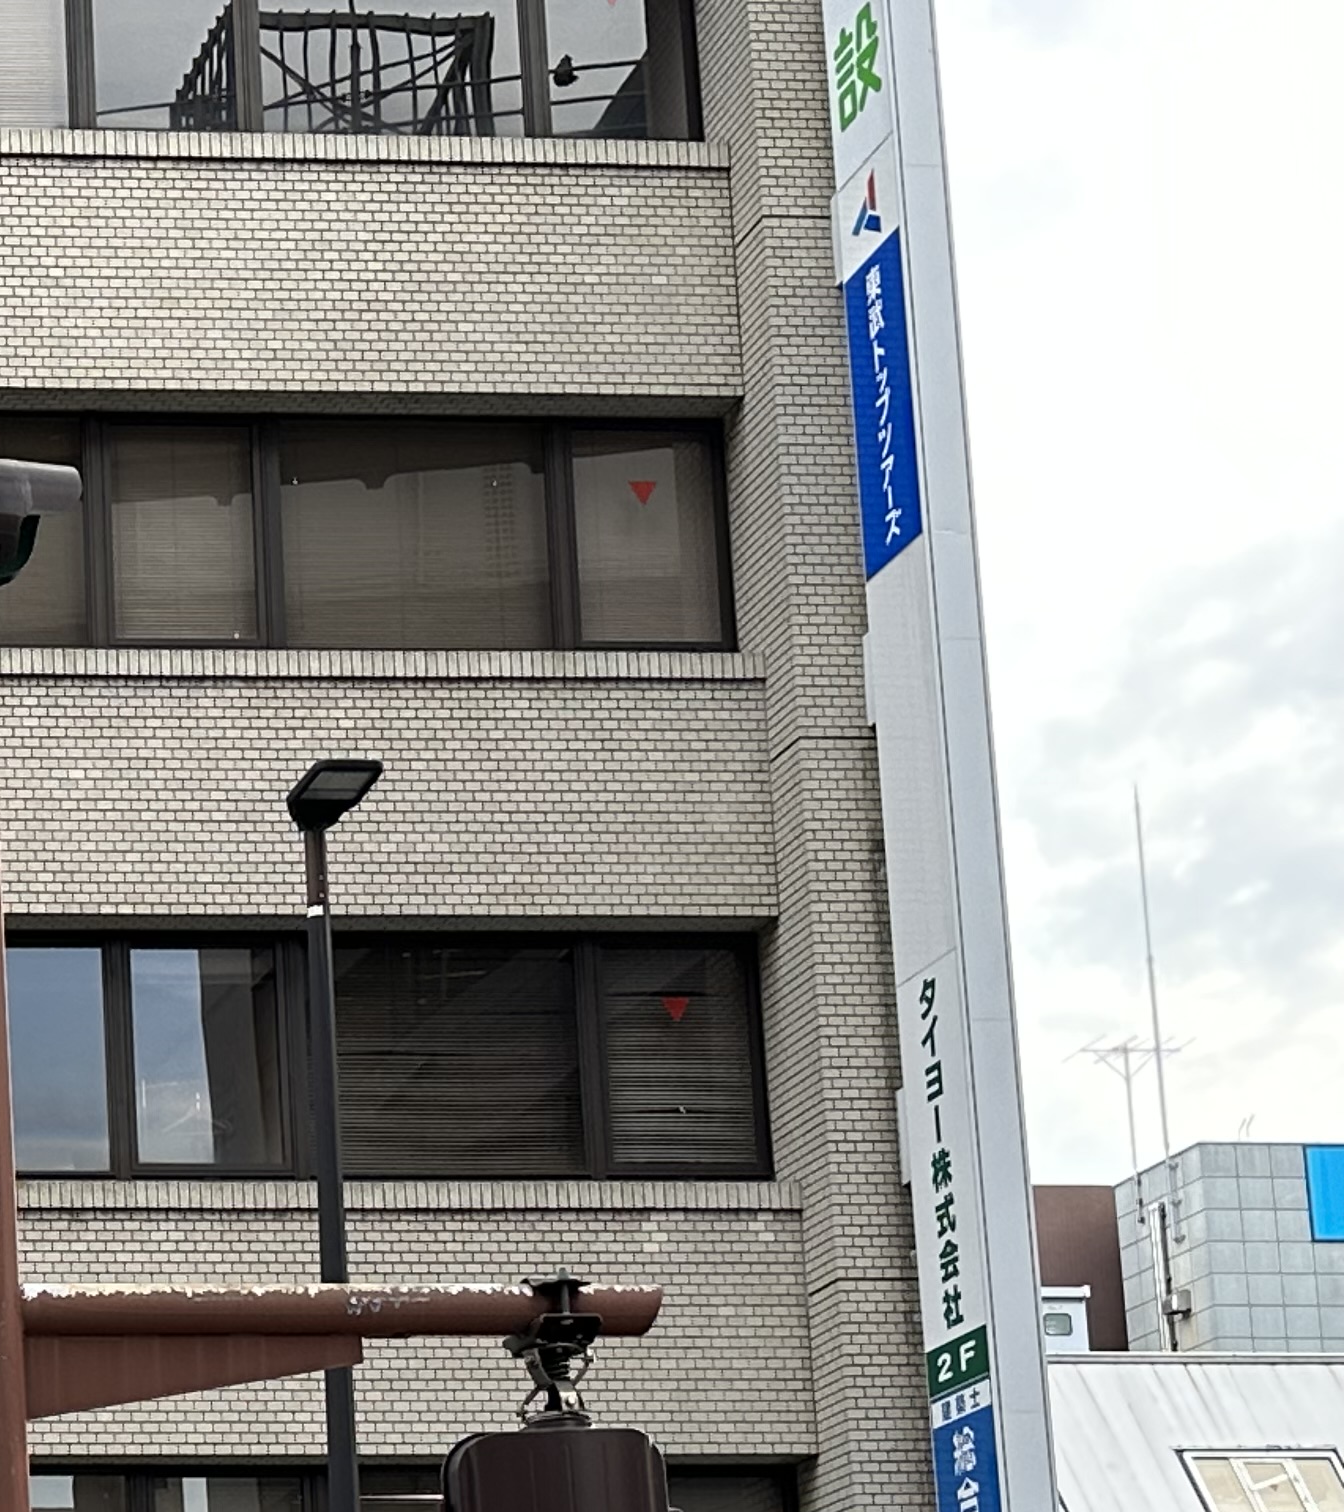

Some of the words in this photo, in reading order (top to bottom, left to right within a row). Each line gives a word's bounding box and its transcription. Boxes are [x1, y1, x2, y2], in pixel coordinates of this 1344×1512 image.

[833, 1, 883, 133] 設
[864, 263, 902, 548] 東武トップツアーズ
[918, 977, 964, 1330] タイヨー株式会社
[936, 1340, 976, 1384] 2F
